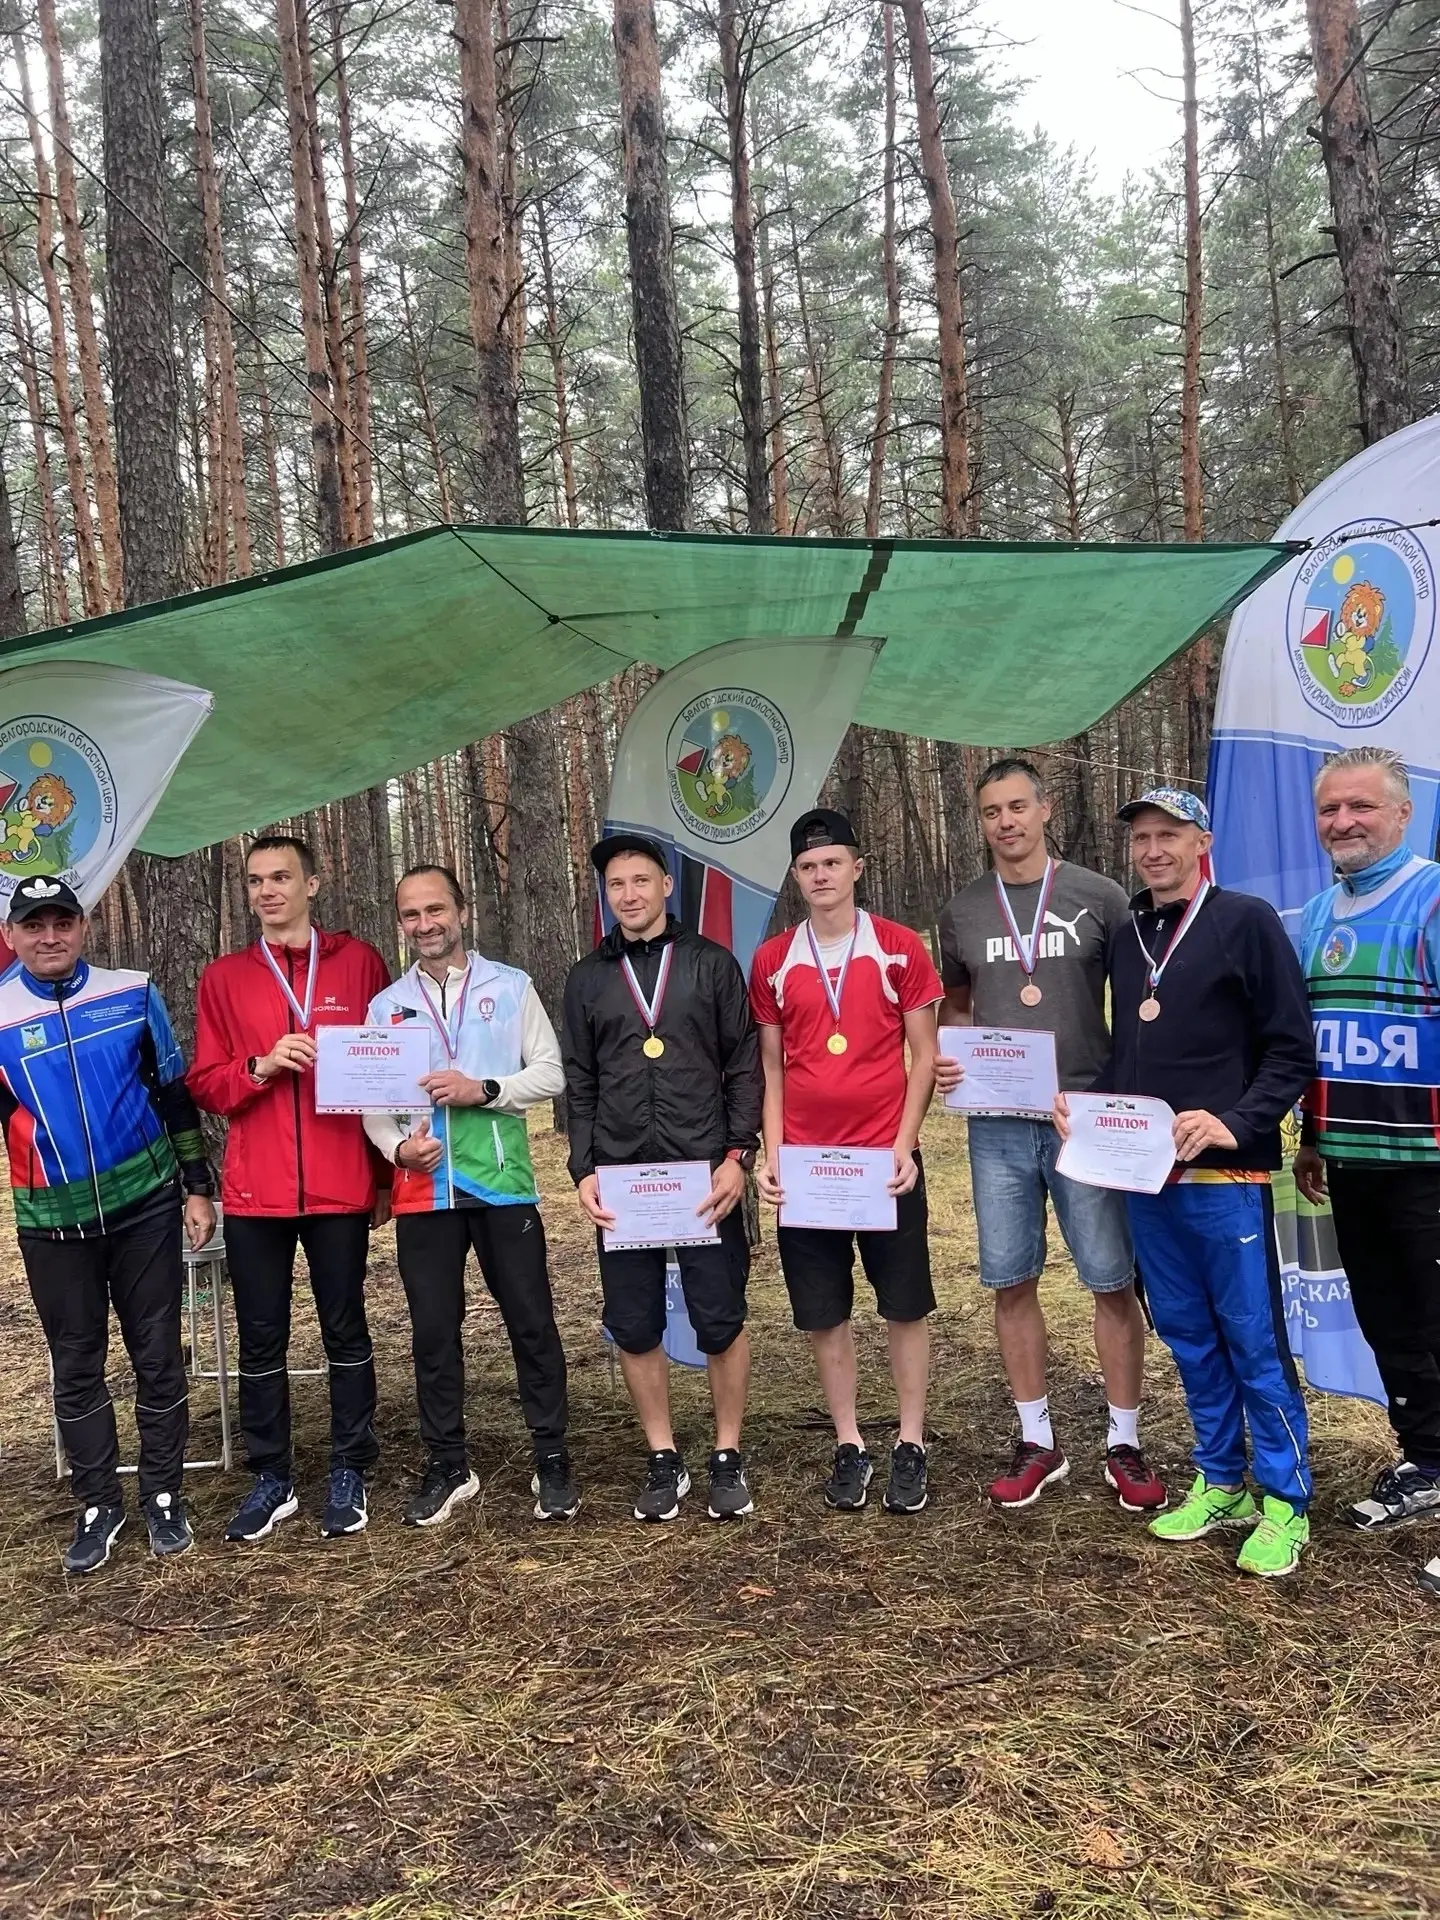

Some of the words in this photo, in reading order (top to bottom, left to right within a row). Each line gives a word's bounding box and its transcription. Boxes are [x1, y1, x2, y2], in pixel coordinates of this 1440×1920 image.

[1411, 559, 1430, 600] центр
[682, 691, 744, 723] Белгородский
[745, 695, 786, 735] областной
[778, 733, 789, 764] центр
[68, 732, 111, 786] областной
[102, 787, 113, 824] центр
[346, 1046, 400, 1057] ДИПЛОМ
[971, 1047, 1026, 1059] ДИПЛОМ
[1312, 1020, 1419, 1072] ДЬЯ
[1094, 1116, 1148, 1130] ДИПЛОМ
[809, 1166, 864, 1176] ДИПЛОМ
[630, 1182, 682, 1195] ДИПЛОМ
